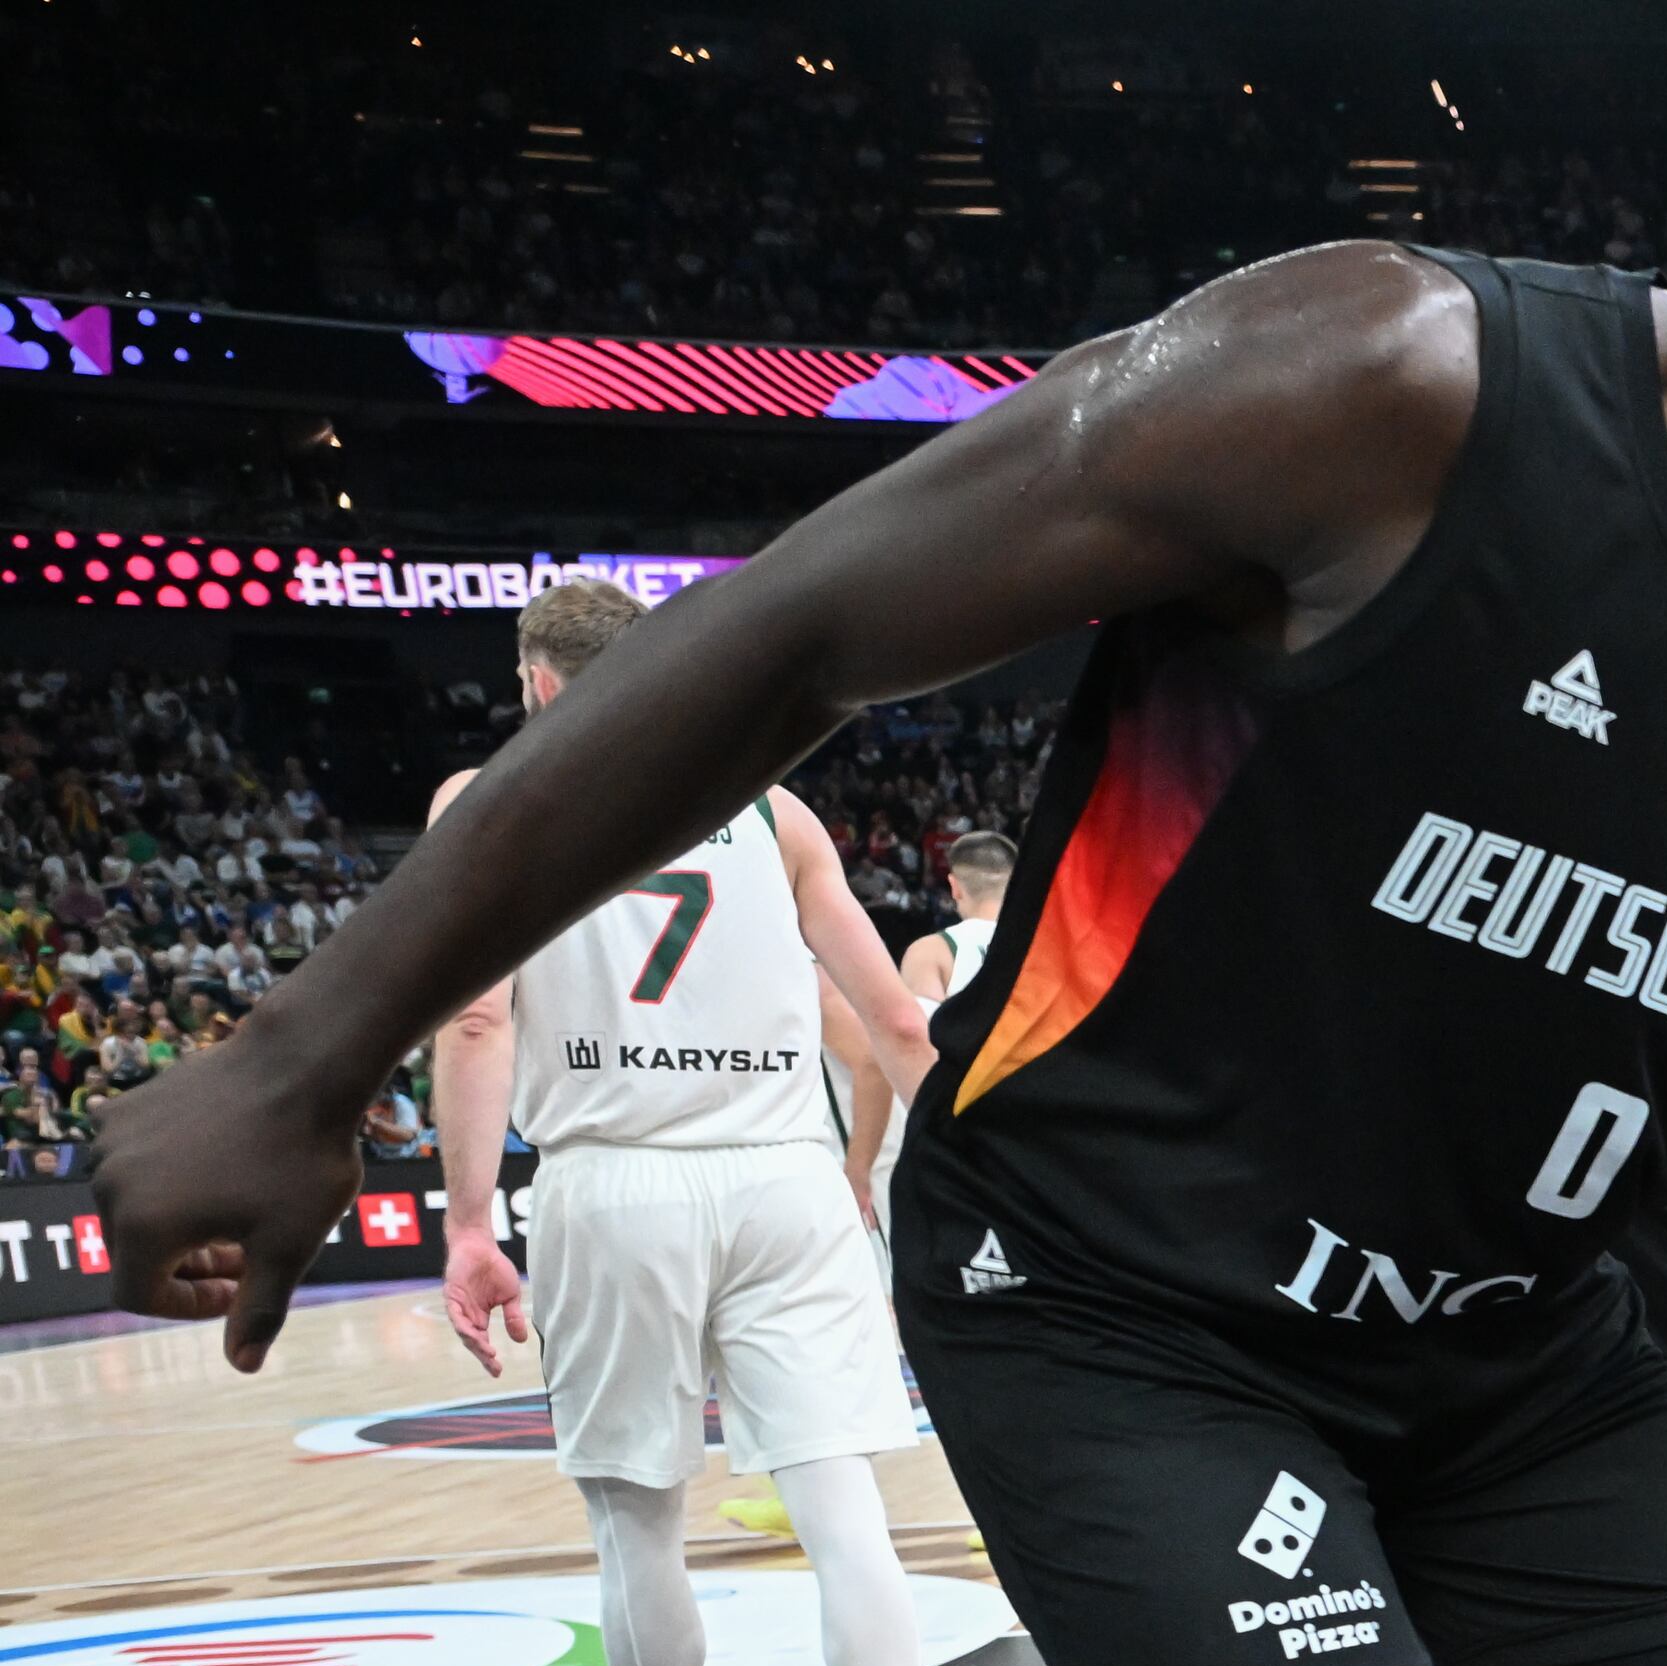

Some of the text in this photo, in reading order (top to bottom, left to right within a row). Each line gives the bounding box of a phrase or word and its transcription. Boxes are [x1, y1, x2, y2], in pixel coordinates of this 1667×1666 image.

[294, 561, 705, 609] #EUROBAKET
[1522, 679, 1618, 746] PEAK
[622, 869, 715, 1005] 7
[618, 1045, 799, 1072] KARYS.LT
[1526, 1081, 1650, 1220] 0
[1227, 1579, 1387, 1634] Domino's
[1278, 1622, 1381, 1660] Pizza
